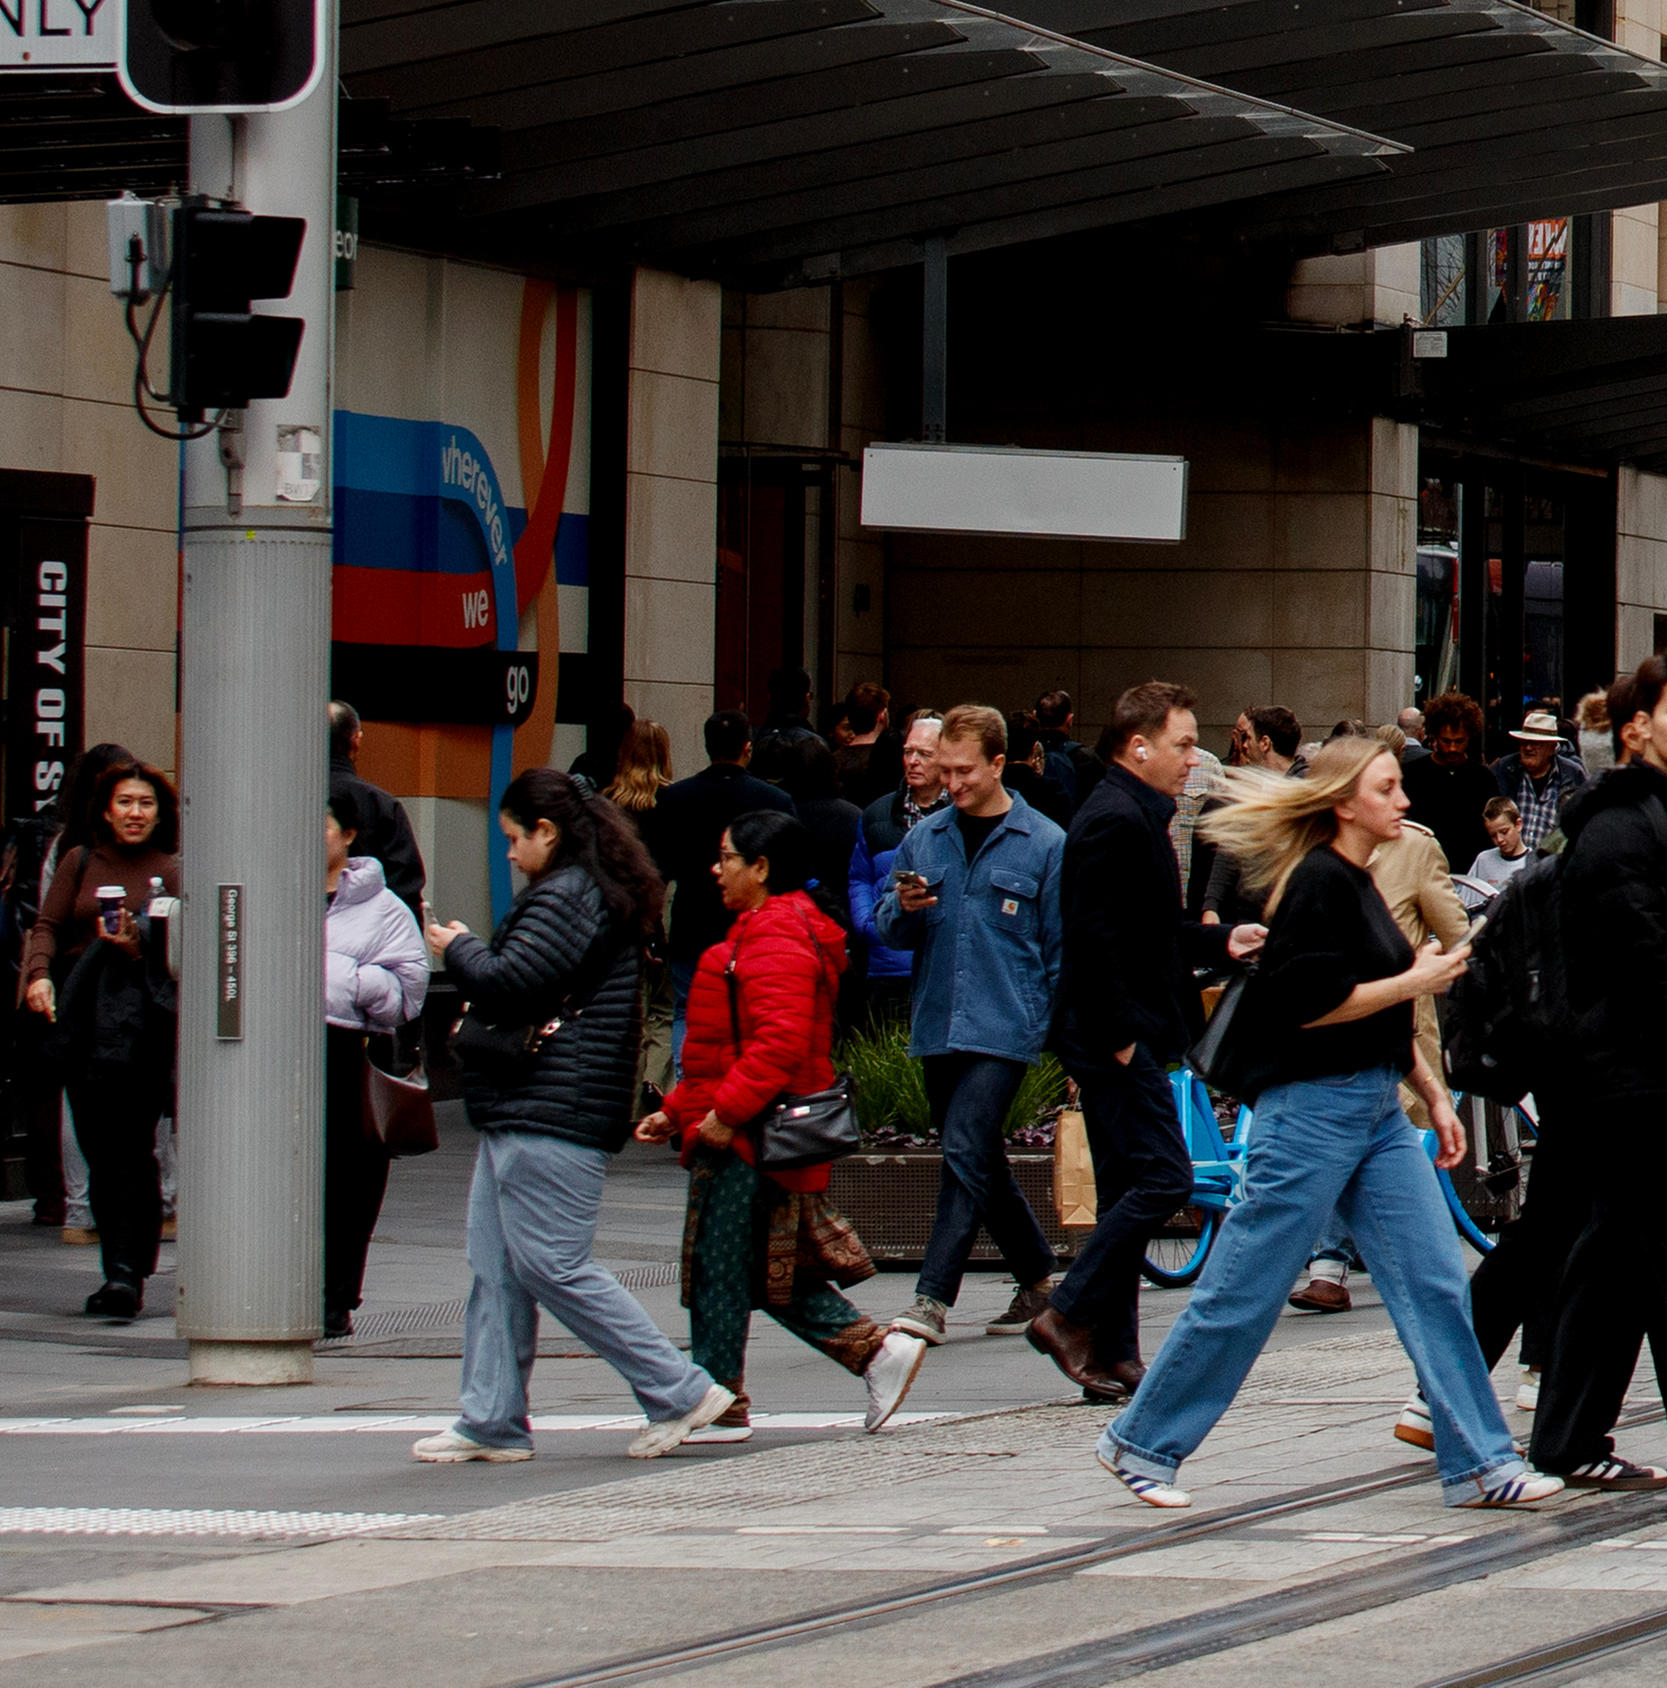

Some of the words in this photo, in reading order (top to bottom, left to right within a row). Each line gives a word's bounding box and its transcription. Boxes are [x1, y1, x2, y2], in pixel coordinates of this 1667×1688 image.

[36, 561, 68, 674] CITY
[462, 588, 489, 629] we
[506, 665, 530, 714] go
[35, 689, 66, 747] OF
[225, 889, 239, 927] George
[226, 930, 238, 941] St
